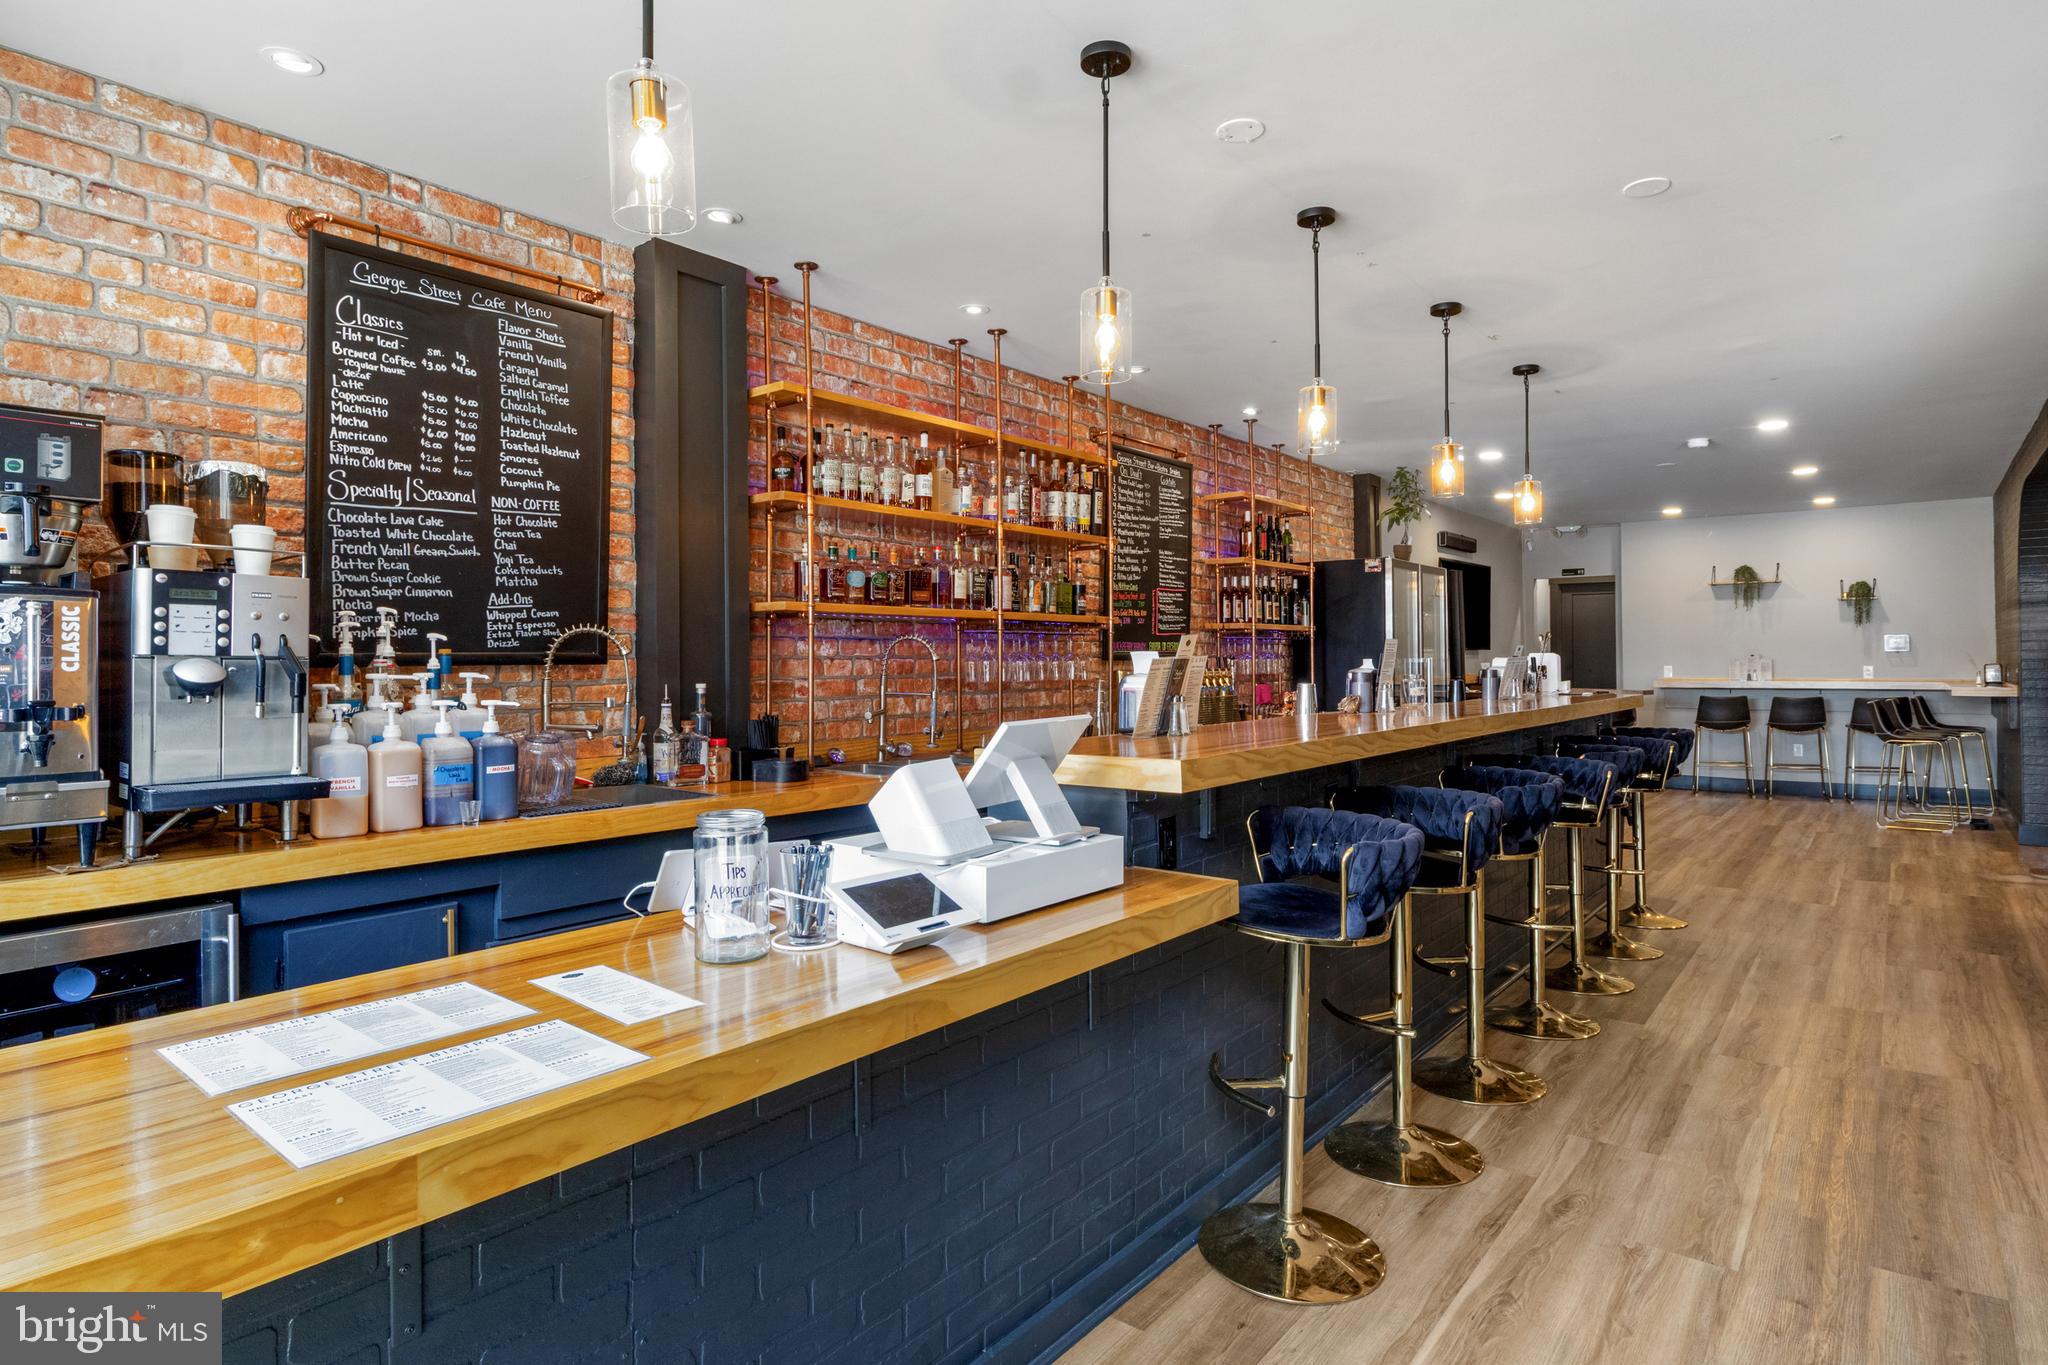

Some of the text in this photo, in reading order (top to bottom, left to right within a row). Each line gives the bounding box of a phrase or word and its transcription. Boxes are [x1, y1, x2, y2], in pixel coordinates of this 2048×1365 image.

[353, 261, 408, 294] George
[419, 279, 462, 301] Street
[515, 301, 552, 319] Menu
[336, 295, 404, 331] Classics
[365, 334, 375, 343] or
[498, 318, 565, 343] Flavor Shots
[499, 335, 534, 351] Vanilla
[332, 341, 478, 377] Brewed Coffee $3.00 $4.50
[427, 347, 470, 367] sm. lg.
[498, 347, 568, 370] French Vanilla
[380, 363, 407, 376] house
[499, 359, 539, 378] Caramel
[332, 374, 480, 408] Latte $5.00 $6.00
[499, 372, 569, 394] Salted Caramel
[331, 387, 479, 419] Cappuccino $5.00 $6.00
[500, 384, 570, 407] English Toffee
[331, 400, 389, 418] Machiatto
[500, 398, 547, 416] Chocolate
[331, 413, 449, 440] Mocha $6.00
[500, 412, 578, 436] White Chocolate
[329, 426, 476, 452] Americano $5.00 $6.00
[500, 425, 547, 441] Hazlenut
[329, 440, 375, 457] Espresso
[499, 438, 581, 460] Toasted Hazlenut
[329, 453, 360, 468] Nitro
[361, 456, 386, 470] Cold
[387, 459, 412, 472] Brew
[420, 463, 442, 473] $4.00
[499, 451, 540, 465] Smores
[500, 464, 544, 477] Coconut
[327, 469, 477, 508] Specialty Seasonal
[500, 476, 561, 492] Pumpkin Pie
[491, 495, 560, 512] NON-COFFEE
[327, 508, 444, 527] Chocolate Lava Cake
[493, 513, 559, 529] Hot Chocolate
[328, 524, 475, 542] Toasted White Chocolate
[493, 527, 543, 539] Green Tea
[331, 539, 378, 555] French
[379, 542, 411, 556] Vanill
[494, 539, 517, 551] Chai
[331, 555, 410, 571] Butter Pecan
[493, 551, 535, 567] Yogi Tea
[331, 570, 442, 588] Brown Sugar Cookie
[494, 565, 564, 576] Coke Products
[495, 576, 539, 587] Matcha
[332, 583, 371, 598] Brown
[371, 586, 403, 600] Sugar
[488, 592, 534, 606] Add-Ons
[332, 599, 374, 611] Mocha
[404, 611, 440, 623] Mocha
[486, 608, 560, 623] Whipped Cream
[389, 625, 419, 638] Spice
[486, 621, 557, 632] Extra Espresso
[486, 630, 512, 639] Extra
[515, 630, 541, 638] Flavor
[61, 605, 80, 672] CLASSIC
[487, 638, 520, 648] Drizzle
[238, 1081, 335, 1109] GEORGE
[344, 1058, 418, 1081] STREET
[429, 1037, 498, 1059] BISTRO
[524, 1020, 559, 1033] BAR
[287, 1127, 333, 1143] SALADS
